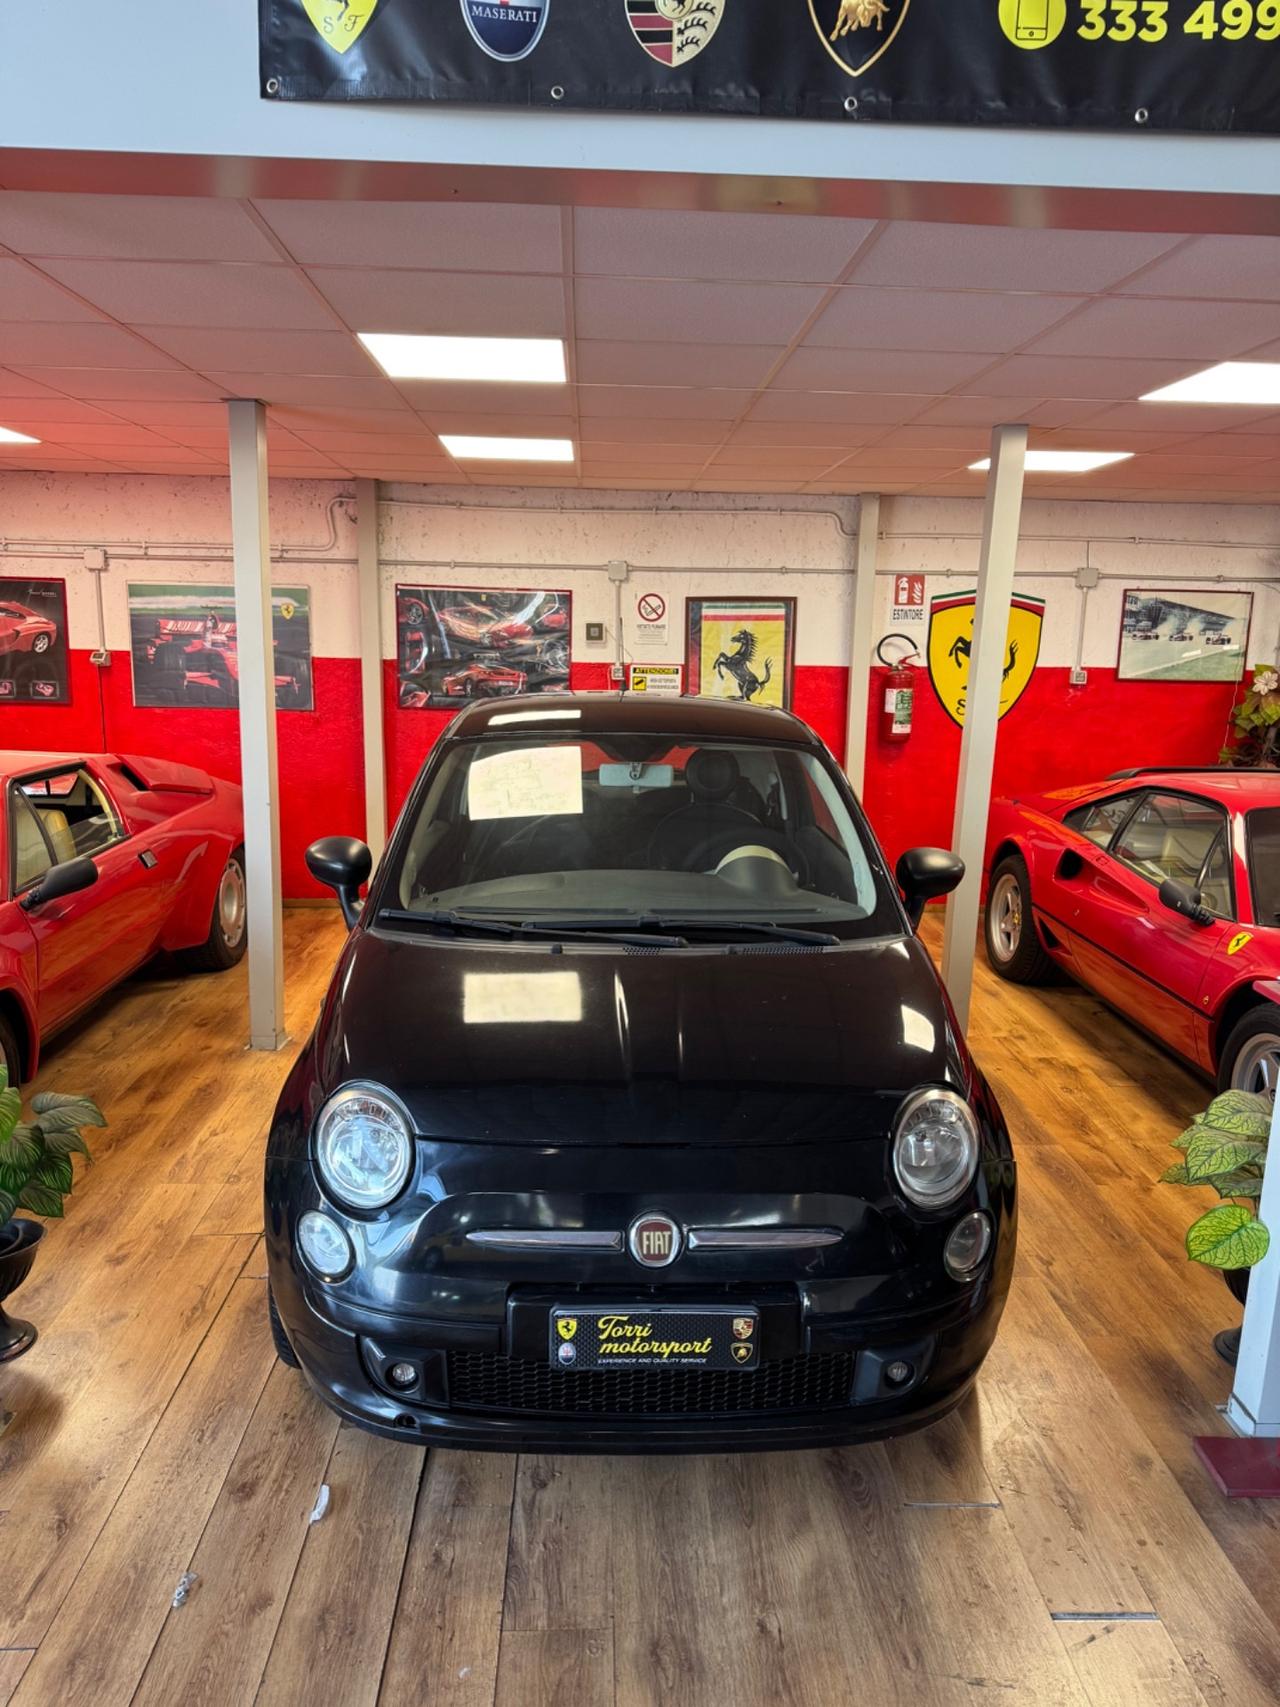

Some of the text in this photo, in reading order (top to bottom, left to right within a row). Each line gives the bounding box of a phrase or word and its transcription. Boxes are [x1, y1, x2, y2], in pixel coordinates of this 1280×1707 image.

[323, 14, 365, 33] S F
[471, 5, 538, 23] MASERATI
[1076, 0, 1280, 43] 333 499
[893, 608, 924, 620] ESTINTORE
[642, 1231, 672, 1255] FIAT
[597, 1315, 653, 1340] Torri
[598, 1337, 712, 1359] motorsport
